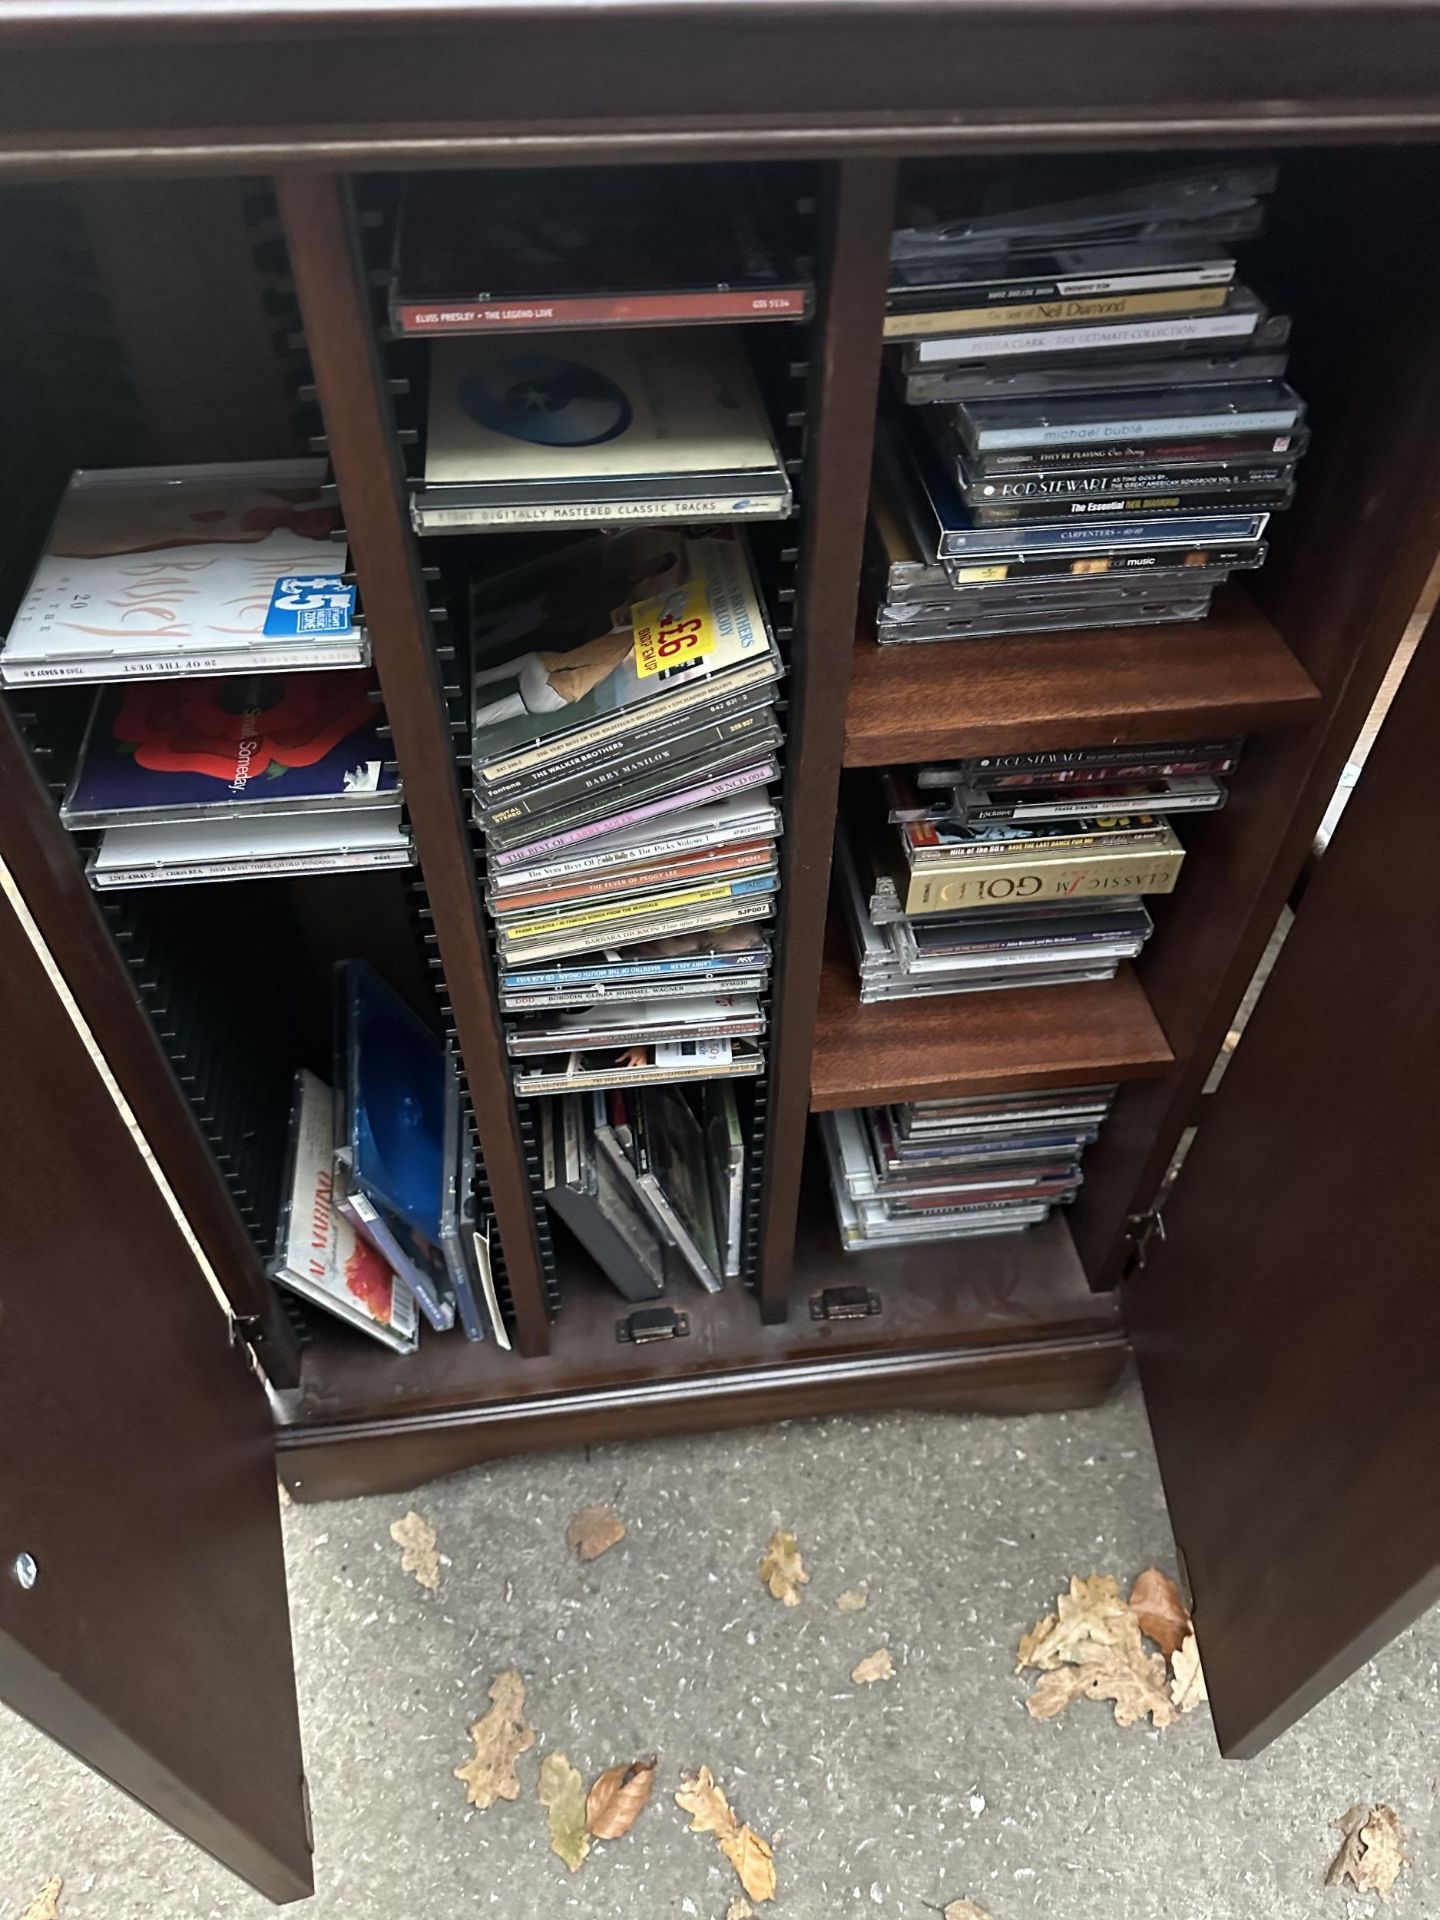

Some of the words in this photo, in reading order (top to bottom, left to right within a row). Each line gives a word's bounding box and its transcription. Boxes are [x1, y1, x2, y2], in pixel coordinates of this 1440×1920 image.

[415, 313, 439, 323] ELVIS
[440, 312, 475, 322] PRESLEY
[485, 311, 501, 320] THE
[502, 310, 534, 320] LEGEND
[535, 308, 554, 318] LIVE
[1037, 304, 1062, 318] Neil
[1066, 299, 1127, 317] Diamond
[1011, 338, 1046, 349] CLARK
[1056, 334, 1076, 345] THE
[1078, 330, 1129, 344] ULTIMATE
[1131, 324, 1196, 340] COLLECTION
[1044, 428, 1098, 441] michael
[1072, 450, 1106, 459] PLAYING
[1002, 482, 1036, 496] ROD
[1040, 478, 1111, 493] STEWART
[482, 510, 547, 520] DIGITALLY
[554, 506, 612, 516] MASTERED
[618, 504, 667, 514] CLASSIC
[675, 502, 717, 512] TRACKS
[1071, 504, 1086, 512] The
[1088, 501, 1124, 512] Essential
[1060, 530, 1115, 540] CARPENTERS
[1126, 556, 1156, 566] music
[70, 594, 92, 610] 20
[304, 610, 316, 630] ZONE
[712, 599, 734, 637] MELODY
[730, 594, 755, 649] BROTHERS
[658, 618, 702, 658] £6
[638, 627, 652, 647] SNAP
[645, 661, 658, 672] UP
[123, 662, 152, 672] BEST
[155, 662, 182, 670] THE
[186, 660, 200, 669] OF
[536, 750, 549, 758] THE
[550, 745, 564, 755] VERY
[565, 740, 580, 749] BEST
[589, 731, 601, 740] THE
[602, 718, 635, 736] RIGHTEOUS
[636, 706, 668, 722] BROTHERS
[708, 680, 733, 693] MELODY
[488, 780, 522, 797] Fontana
[532, 770, 548, 780] THE
[548, 758, 581, 776] WALKER
[581, 742, 624, 762] BROTHERS
[656, 723, 672, 732] LIGHTS
[678, 716, 690, 725] OUT
[710, 704, 724, 712] 842
[228, 742, 257, 794] Someday.
[585, 770, 620, 788] BARRY
[622, 750, 672, 774] MANILOW
[492, 806, 520, 820] DIGITAL
[494, 810, 522, 824] STEREO
[506, 852, 526, 863] THE
[528, 842, 551, 856] BEST
[552, 836, 566, 848] OF
[570, 826, 602, 840] LARRY
[602, 815, 634, 831] ADLER
[711, 776, 748, 794] SWNCD
[748, 771, 765, 784] 004
[654, 842, 675, 852] Picks
[166, 868, 188, 878] CHRIS
[188, 868, 203, 876] REA
[210, 866, 226, 874] NEW
[301, 858, 336, 866] WINDOWS
[588, 882, 602, 891] THE
[604, 878, 627, 890] FEVER
[628, 877, 639, 885] OF
[639, 872, 665, 884] PEGGY
[665, 869, 679, 878] LEE
[940, 876, 1043, 901] GOLD
[1088, 872, 1171, 890] CLASSIC
[534, 922, 556, 932] SINATRA
[566, 916, 588, 926] FAMOUS
[588, 913, 606, 922] SONGS
[606, 910, 622, 918] FROM
[632, 902, 659, 912] MUSICALS
[584, 934, 622, 946] BARBARA
[622, 926, 660, 938] DICKSON
[662, 922, 678, 930] Time
[738, 906, 767, 916] SJP007
[630, 964, 660, 974] MAESTRO
[670, 962, 690, 970] ADLER
[691, 960, 712, 968] LARRY
[558, 972, 582, 980] ORGAN
[582, 970, 606, 978] MOUTH
